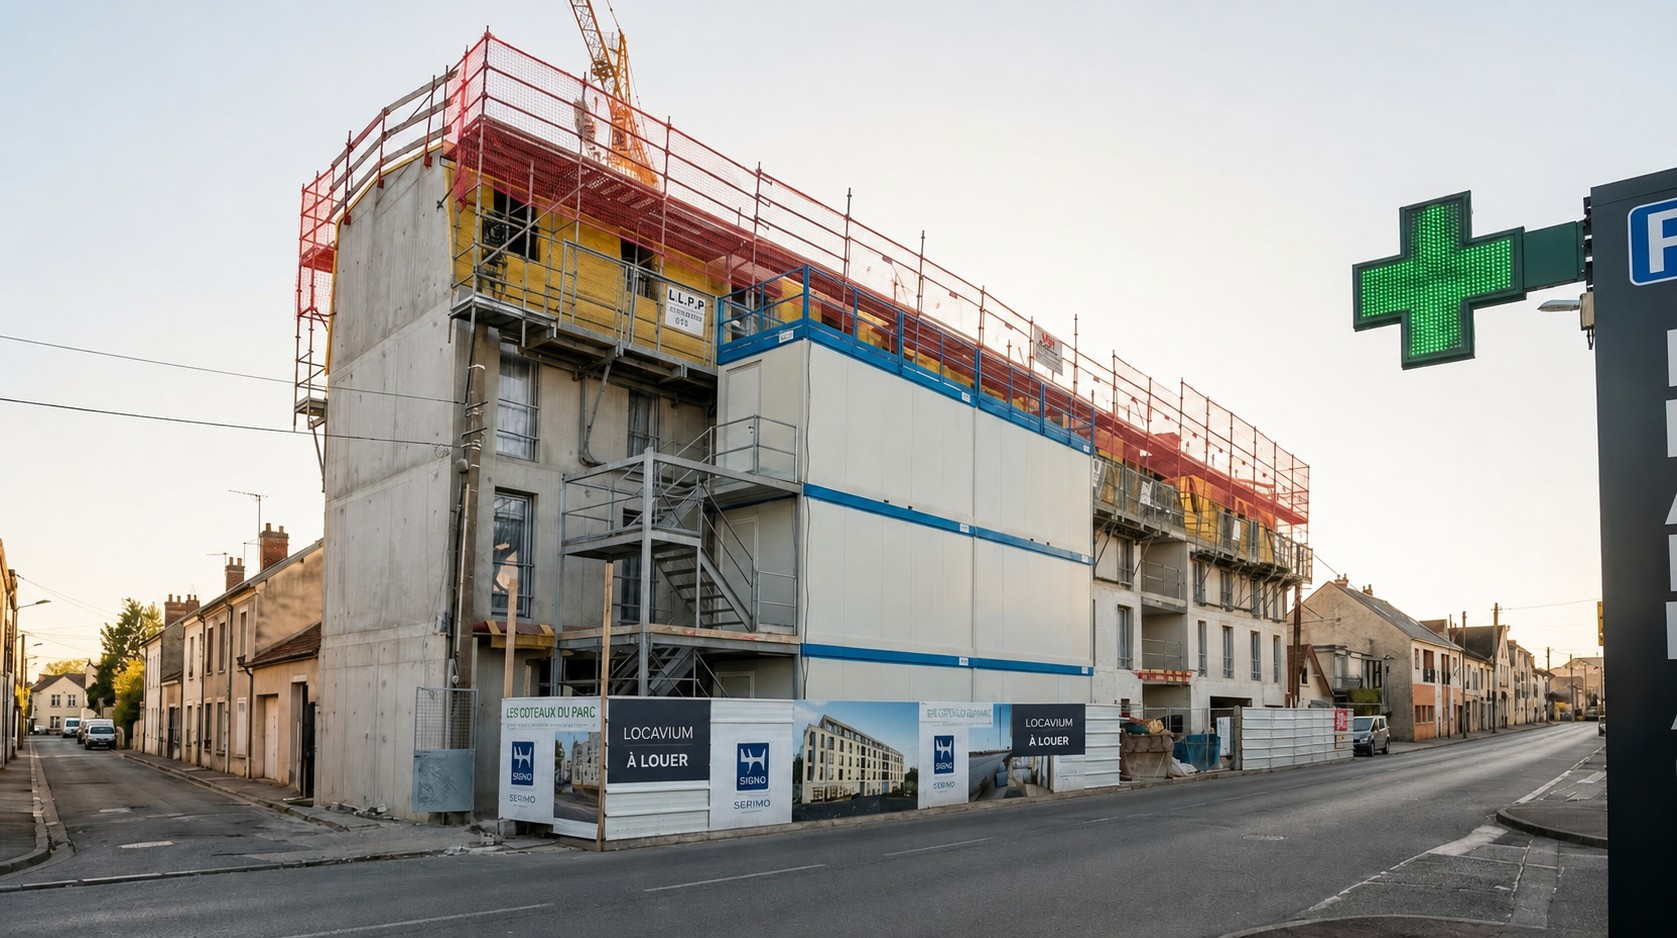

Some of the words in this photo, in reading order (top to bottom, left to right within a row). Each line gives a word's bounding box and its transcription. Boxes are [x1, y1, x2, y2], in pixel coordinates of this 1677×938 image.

[506, 707, 518, 719] LES
[519, 707, 556, 719] COTEAUX
[557, 706, 570, 719] DU
[571, 706, 596, 718] PARC
[1025, 718, 1073, 728] LOCAVIUM
[623, 726, 693, 740] LOCAVIUM
[1028, 733, 1037, 746] À
[1038, 736, 1069, 746] LOUER
[626, 751, 637, 768] À
[641, 753, 688, 768] LOUER
[739, 776, 767, 786] SIGNO
[733, 799, 771, 810] SERIMO
